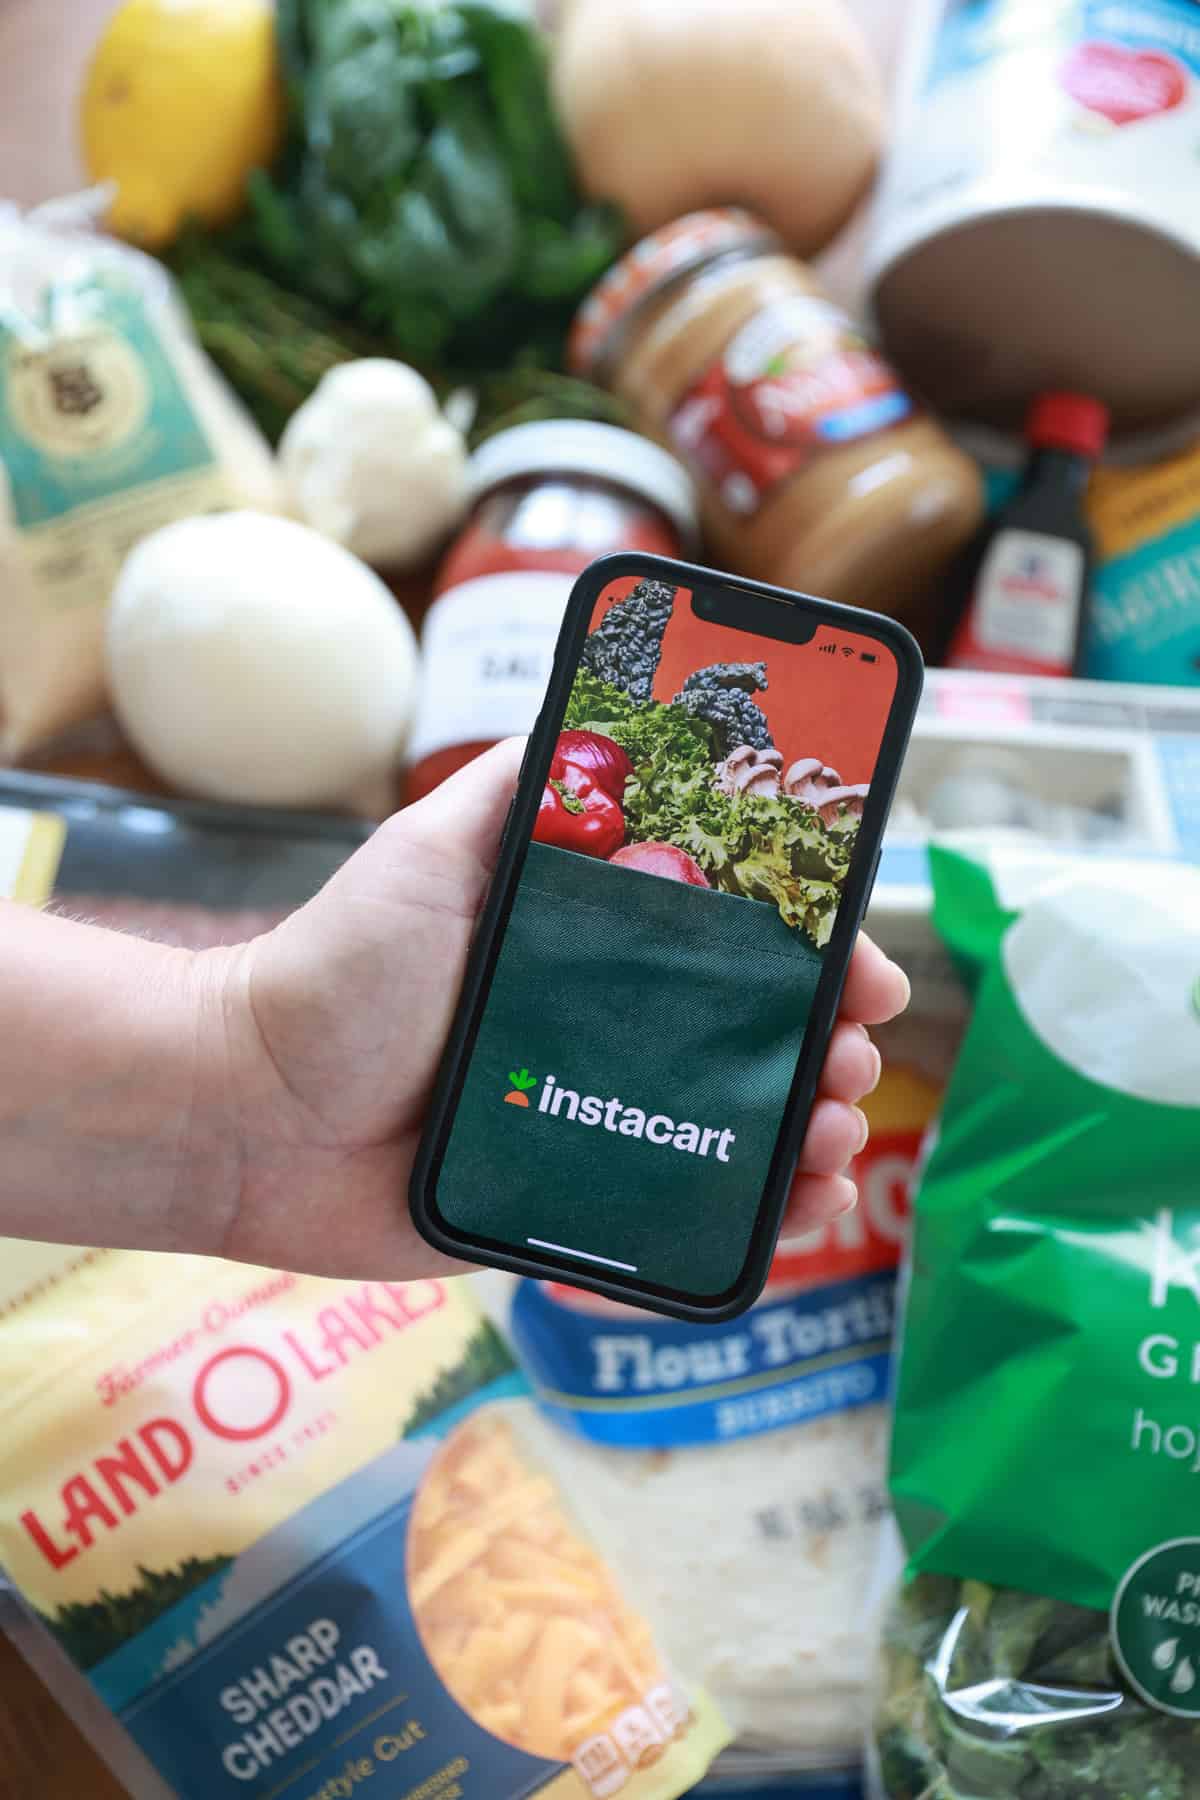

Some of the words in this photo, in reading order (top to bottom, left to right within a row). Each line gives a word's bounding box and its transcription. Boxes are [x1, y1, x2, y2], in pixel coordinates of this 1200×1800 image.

[537, 1074, 737, 1163] instacart
[590, 1333, 750, 1391] Flour
[715, 1364, 878, 1438] BURRITO
[20, 1417, 194, 1572] LAND
[192, 1344, 291, 1442] O
[1142, 1593, 1200, 1626] WAS
[219, 1617, 340, 1724] SHARP
[221, 1646, 389, 1781] CHEDDAR
[374, 1719, 428, 1762] Cut
